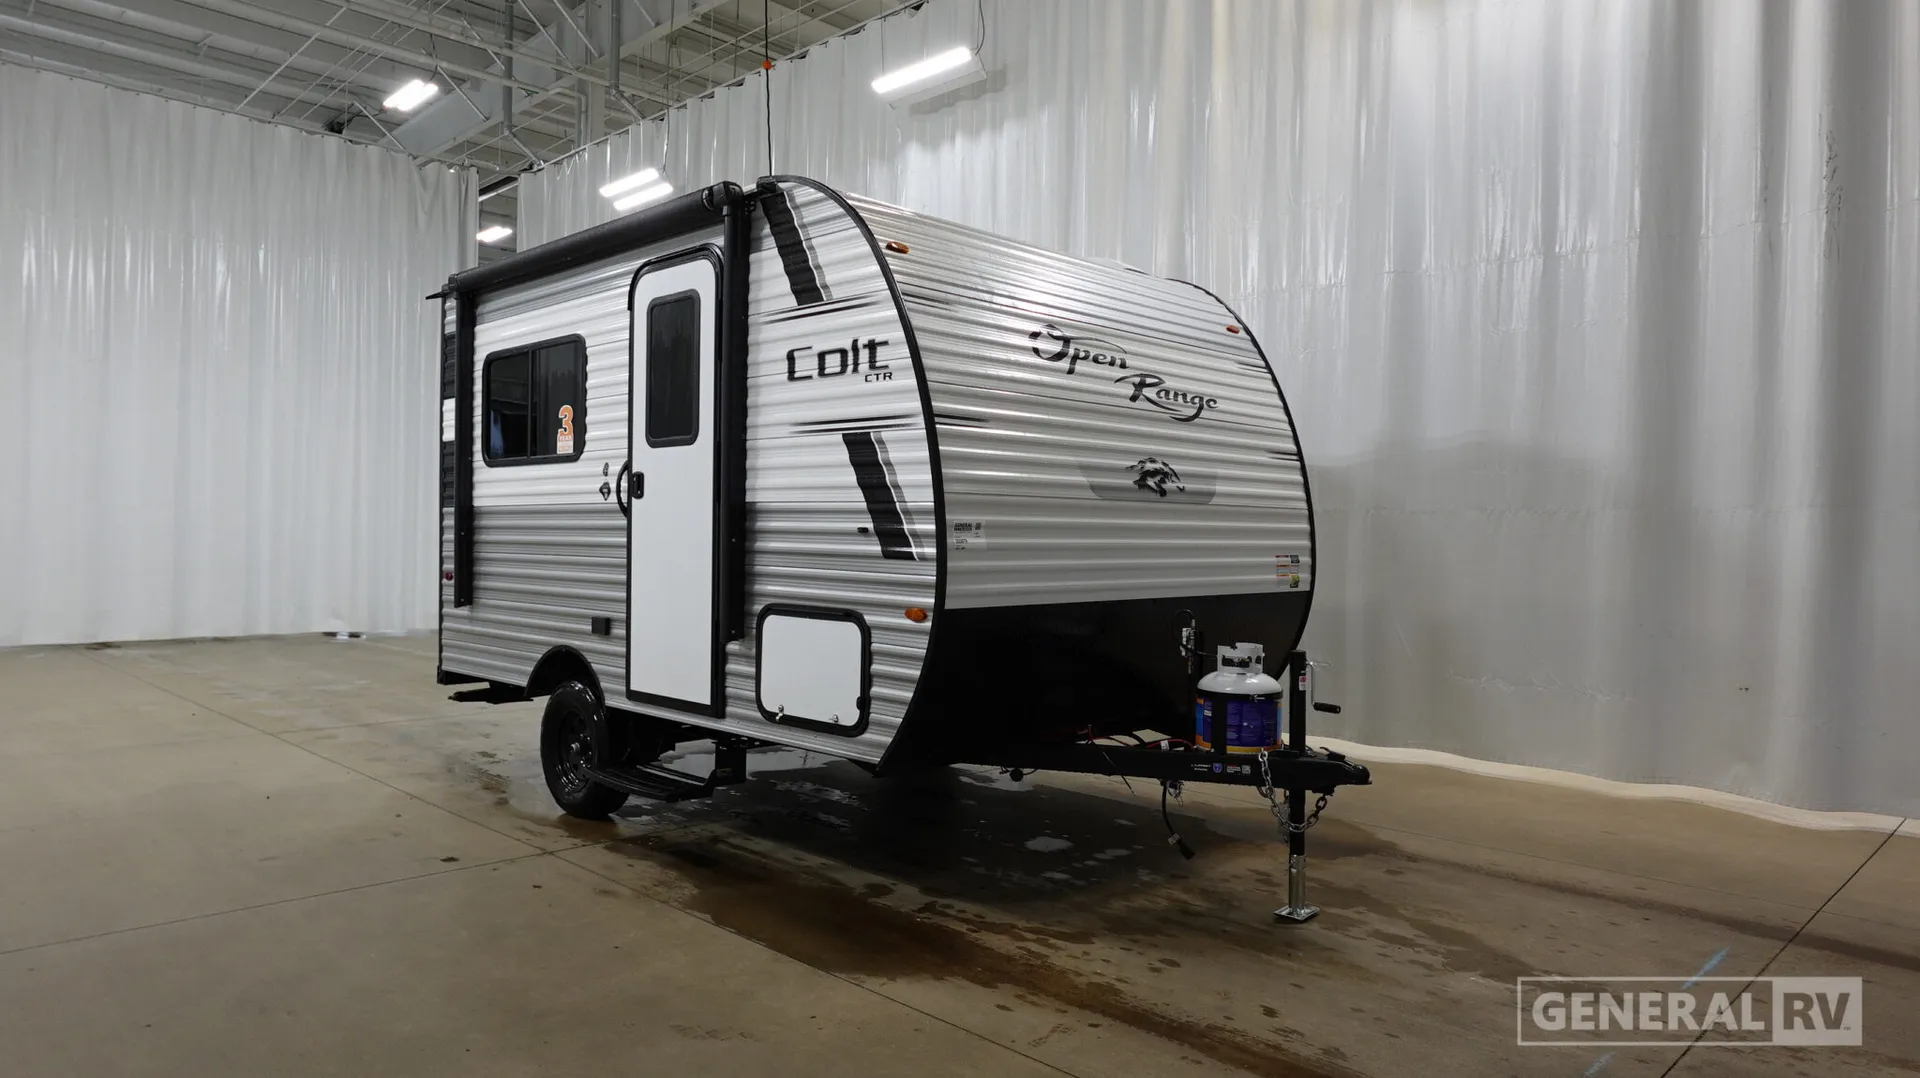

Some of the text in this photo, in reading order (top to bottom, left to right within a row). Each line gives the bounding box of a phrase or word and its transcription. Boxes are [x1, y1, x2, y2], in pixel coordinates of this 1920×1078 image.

[786, 338, 889, 381] Colt
[1028, 323, 1130, 375] Open
[864, 371, 893, 383] CTR
[1114, 373, 1219, 422] Range
[558, 404, 574, 436] 3
